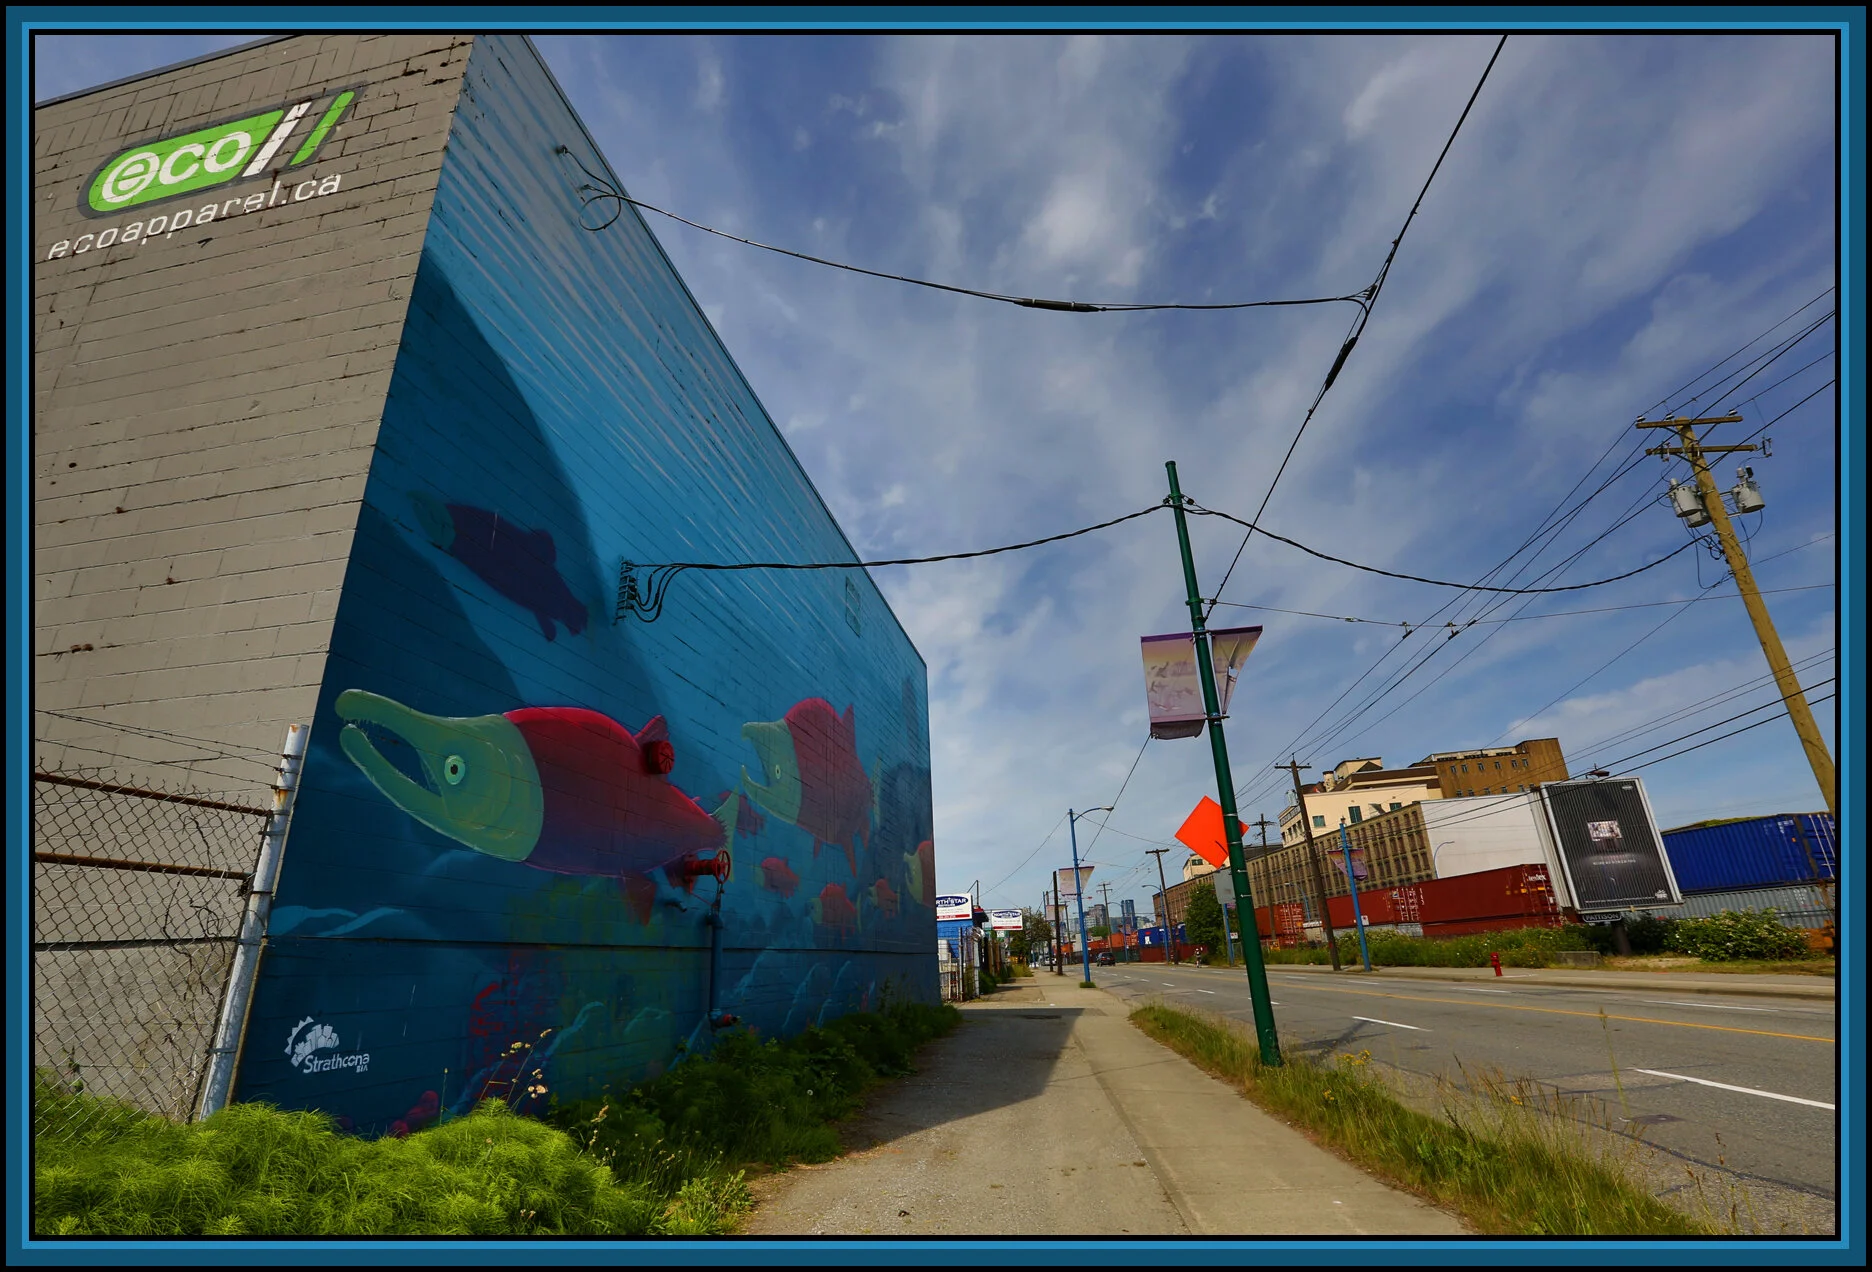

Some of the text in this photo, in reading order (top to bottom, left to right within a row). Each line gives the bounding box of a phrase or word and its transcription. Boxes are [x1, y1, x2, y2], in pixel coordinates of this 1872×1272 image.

[47, 174, 343, 260] ecoapparel.ca
[1585, 913, 1619, 921] PATTISON
[303, 1053, 370, 1073] Strathcona
